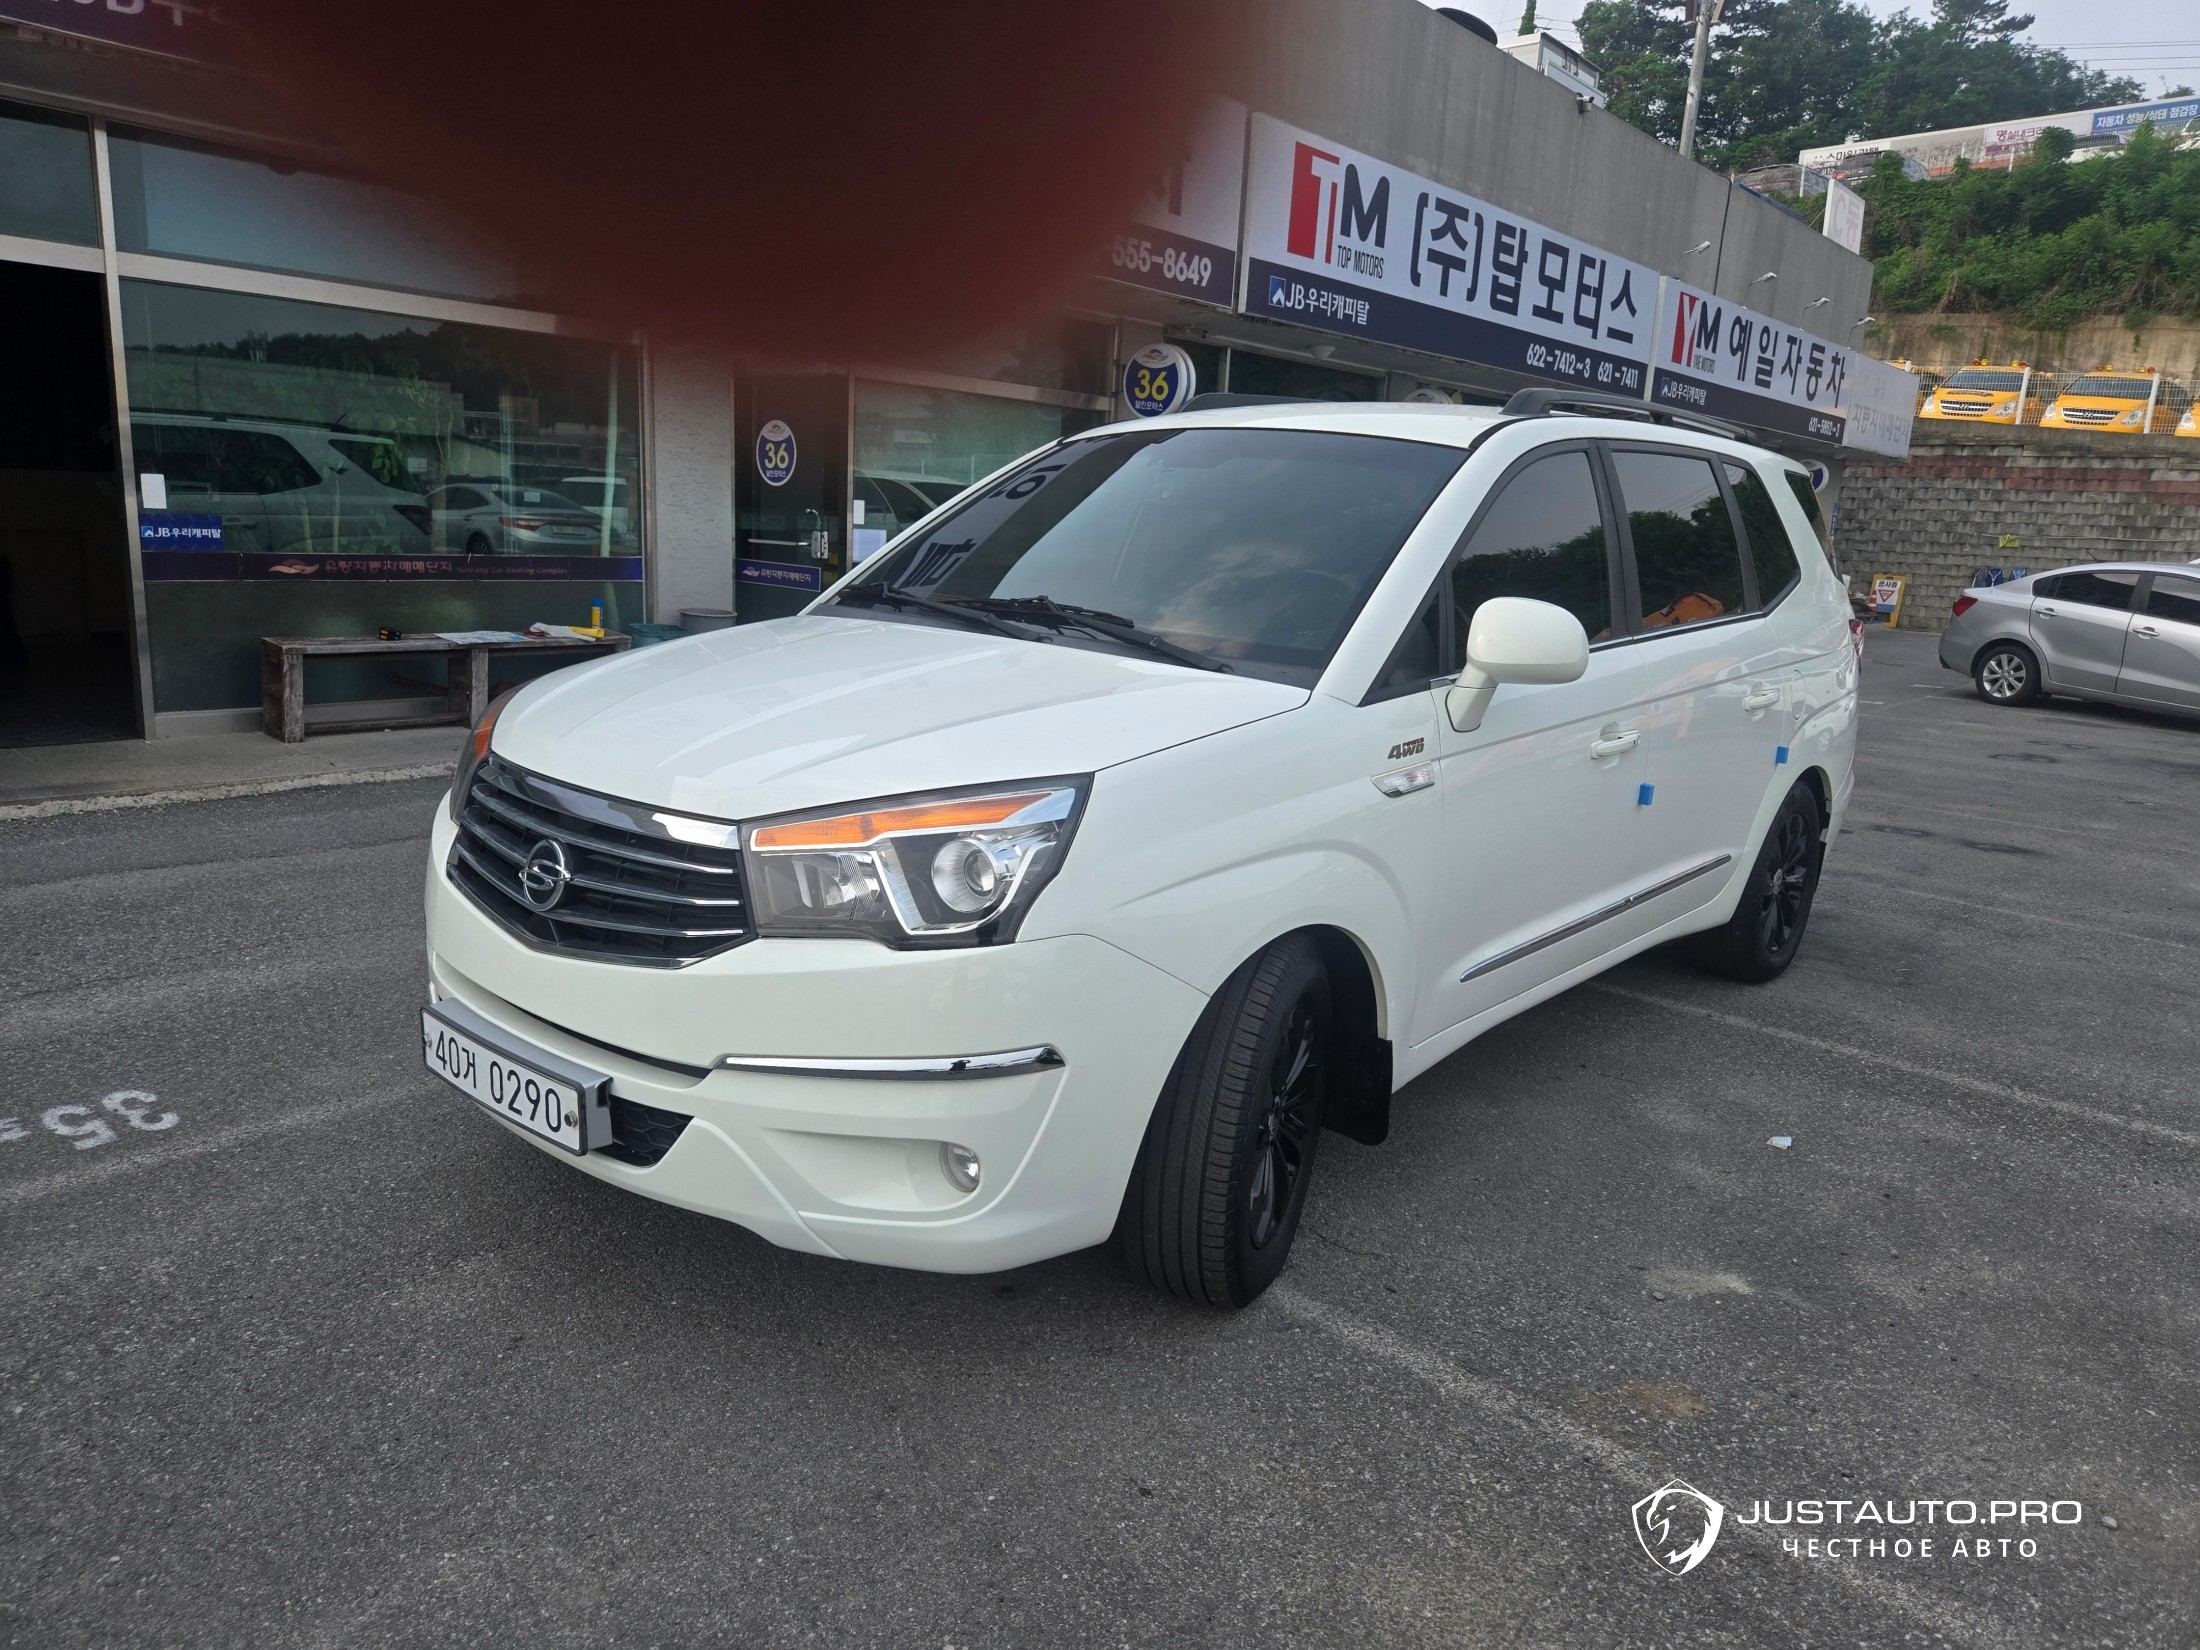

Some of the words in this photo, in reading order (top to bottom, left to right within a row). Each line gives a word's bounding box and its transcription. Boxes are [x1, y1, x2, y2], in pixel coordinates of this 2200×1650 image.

[2096, 114, 2124, 128] 자동차
[2126, 108, 2168, 124] 성능/상태
[2169, 104, 2199, 119] 점검장
[1337, 245, 1351, 268] TOP
[1353, 250, 1384, 280] MOTORS
[1285, 283, 1369, 325] JB우리캐피탈
[1526, 343, 1591, 378] 622-7412~3
[1728, 315, 1845, 408] 예일자동차
[1134, 369, 1169, 401] 36
[764, 442, 789, 469] 36
[155, 527, 221, 539] JB우리캐피탈
[505, 566, 535, 576] Dealing
[536, 567, 568, 576] Complex
[1878, 580, 1898, 588] 공사중
[1388, 743, 1424, 759] 4WD
[435, 1030, 477, 1089] 40거
[489, 1060, 561, 1133] 0290
